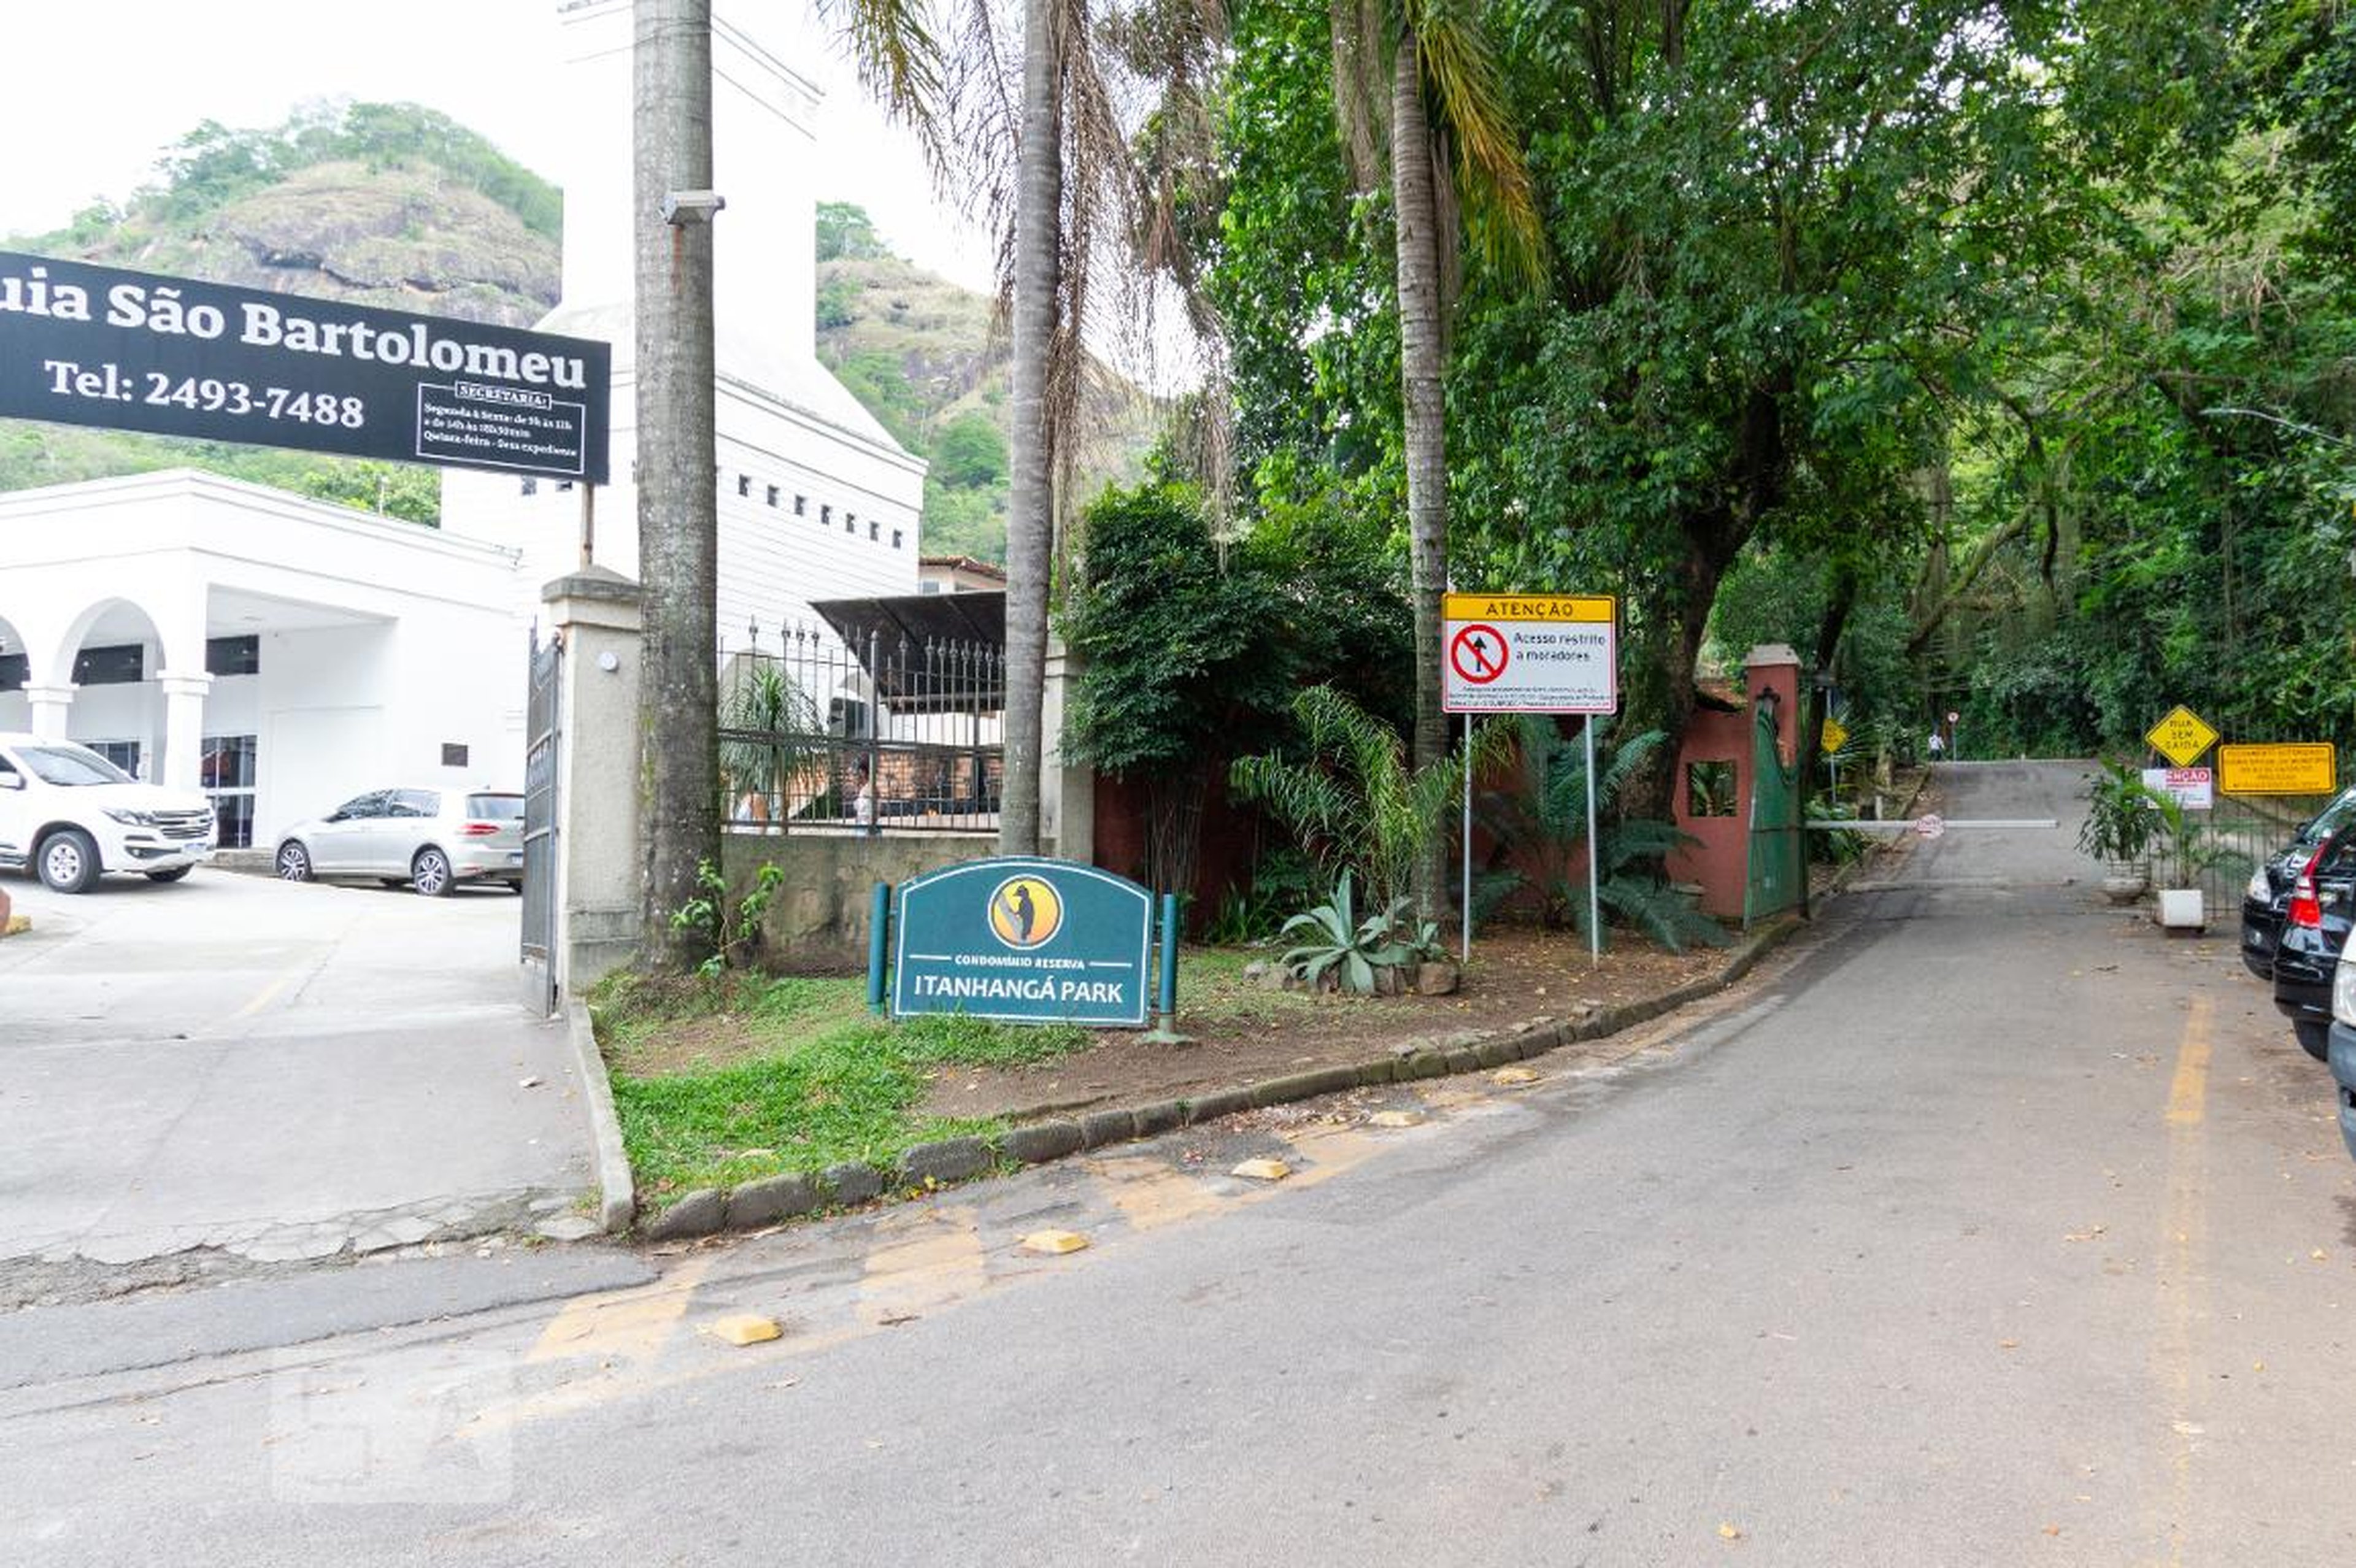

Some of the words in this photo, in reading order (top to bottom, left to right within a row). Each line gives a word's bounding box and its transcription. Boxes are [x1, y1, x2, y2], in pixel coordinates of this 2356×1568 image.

[107, 284, 225, 339] São
[240, 303, 587, 389] Bartolomeu
[44, 359, 134, 402] Tel:
[145, 372, 364, 428] 2493-7488
[460, 385, 547, 405] SECRETARIA:
[1486, 602, 1574, 620] ATENÇÃO
[1514, 632, 1557, 644] Acesso
[1559, 633, 1606, 645] restrito
[1526, 650, 1590, 661] moradores
[954, 954, 1032, 967] CONDOMÍNIO
[1034, 958, 1085, 970] RESERVA
[914, 974, 1056, 1001] ITANHANGÁ
[1061, 981, 1123, 1004] PARK
